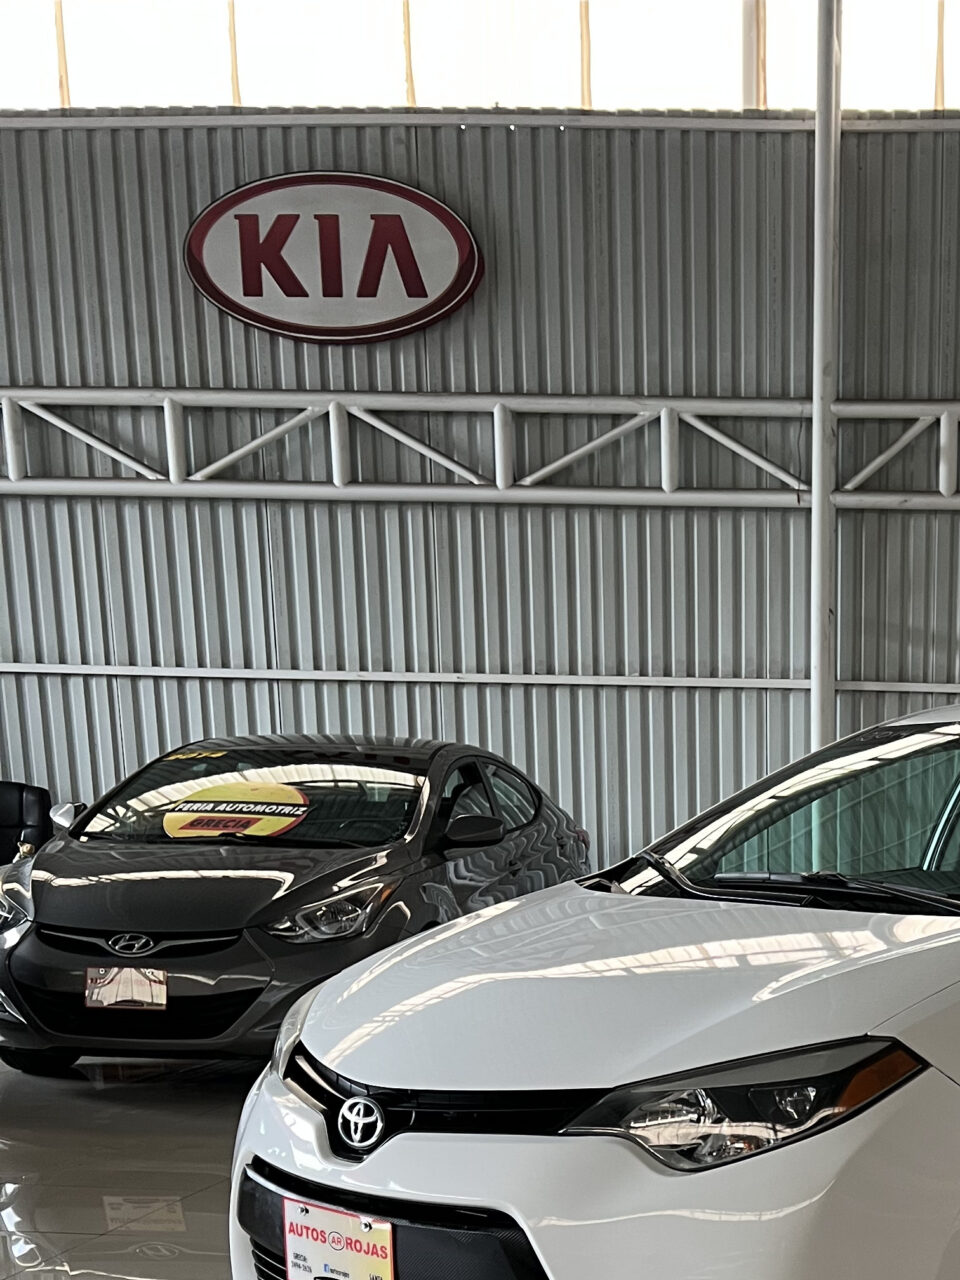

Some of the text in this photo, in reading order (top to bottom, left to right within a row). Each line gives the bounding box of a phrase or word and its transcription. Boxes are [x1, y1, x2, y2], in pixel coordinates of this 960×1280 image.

[234, 213, 428, 298] KIA
[174, 802, 308, 815] FERIA AUTOMOTRIZ
[189, 818, 252, 829] GRECIA
[288, 1221, 388, 1260] AUTOS AR ROJAS
